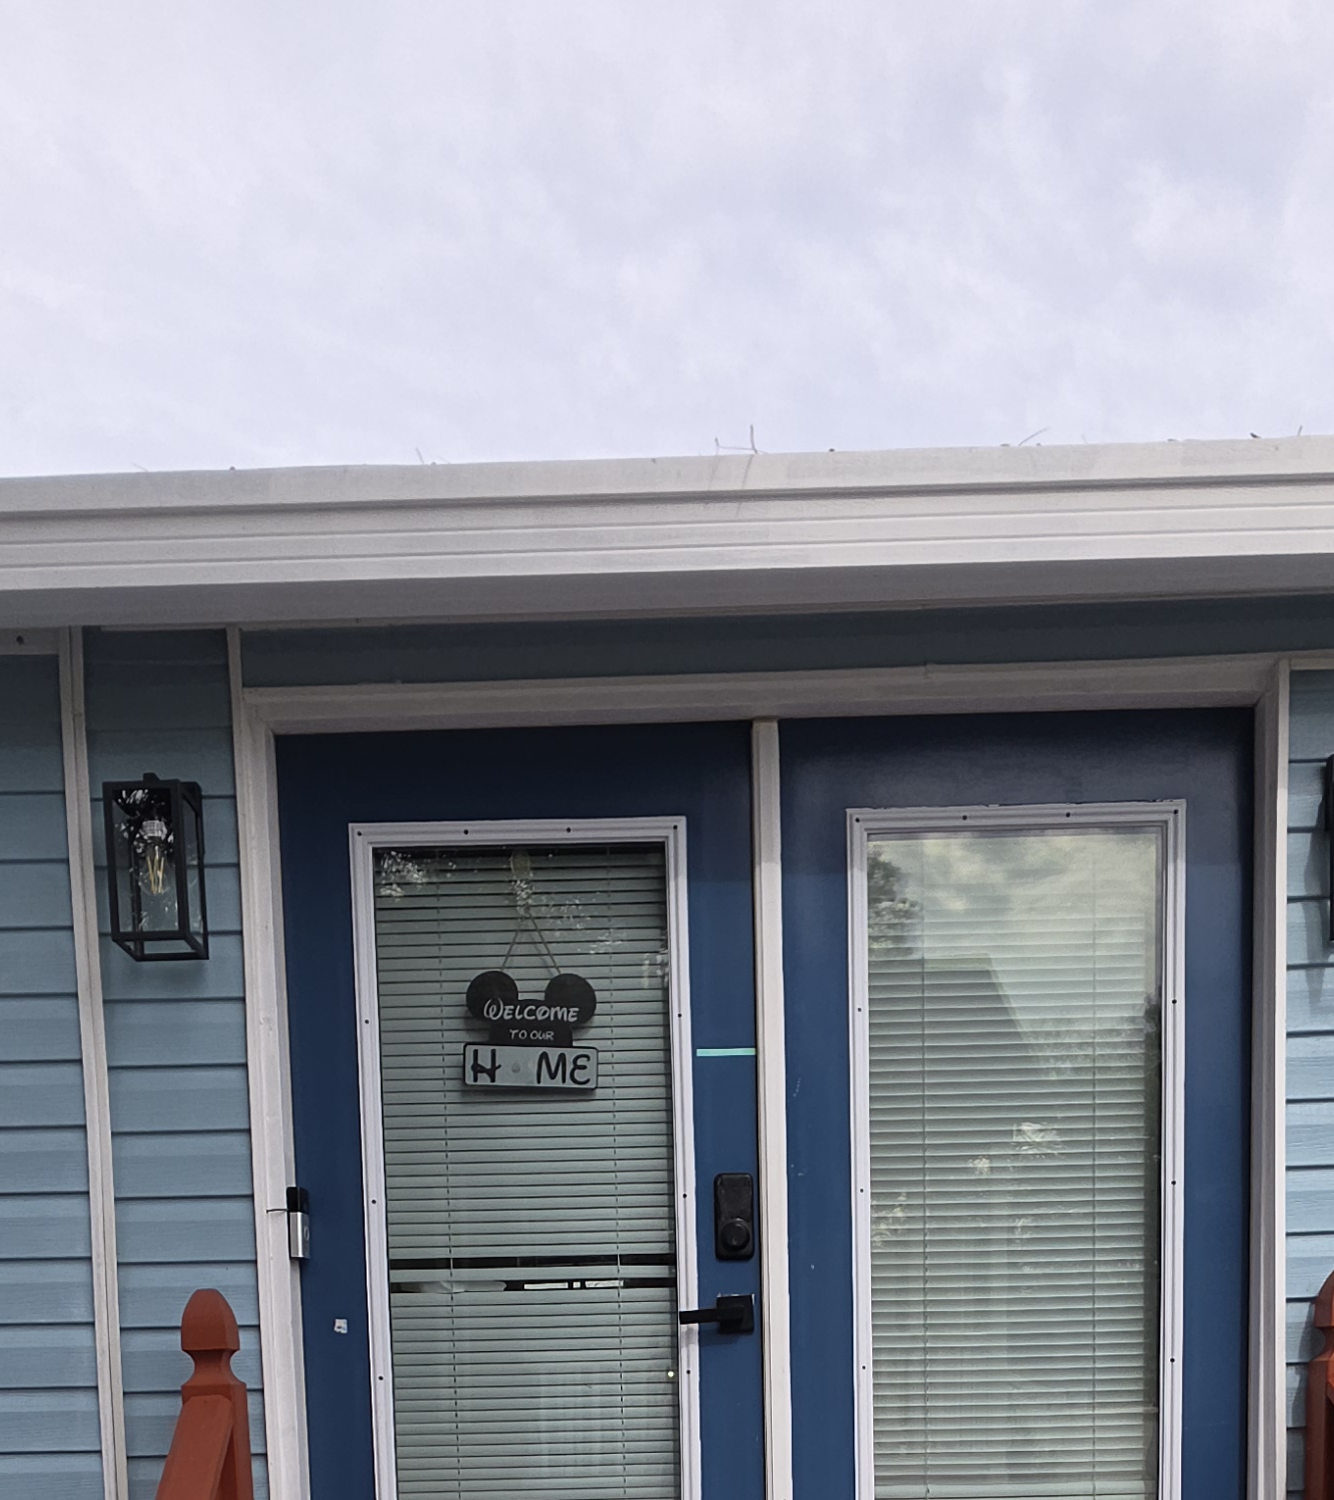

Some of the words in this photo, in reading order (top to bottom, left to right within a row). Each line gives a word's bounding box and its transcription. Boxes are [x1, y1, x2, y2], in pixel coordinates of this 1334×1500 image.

[483, 998, 580, 1022] WELCOME
[509, 1029, 527, 1039] TO
[530, 1030, 555, 1040] OUR
